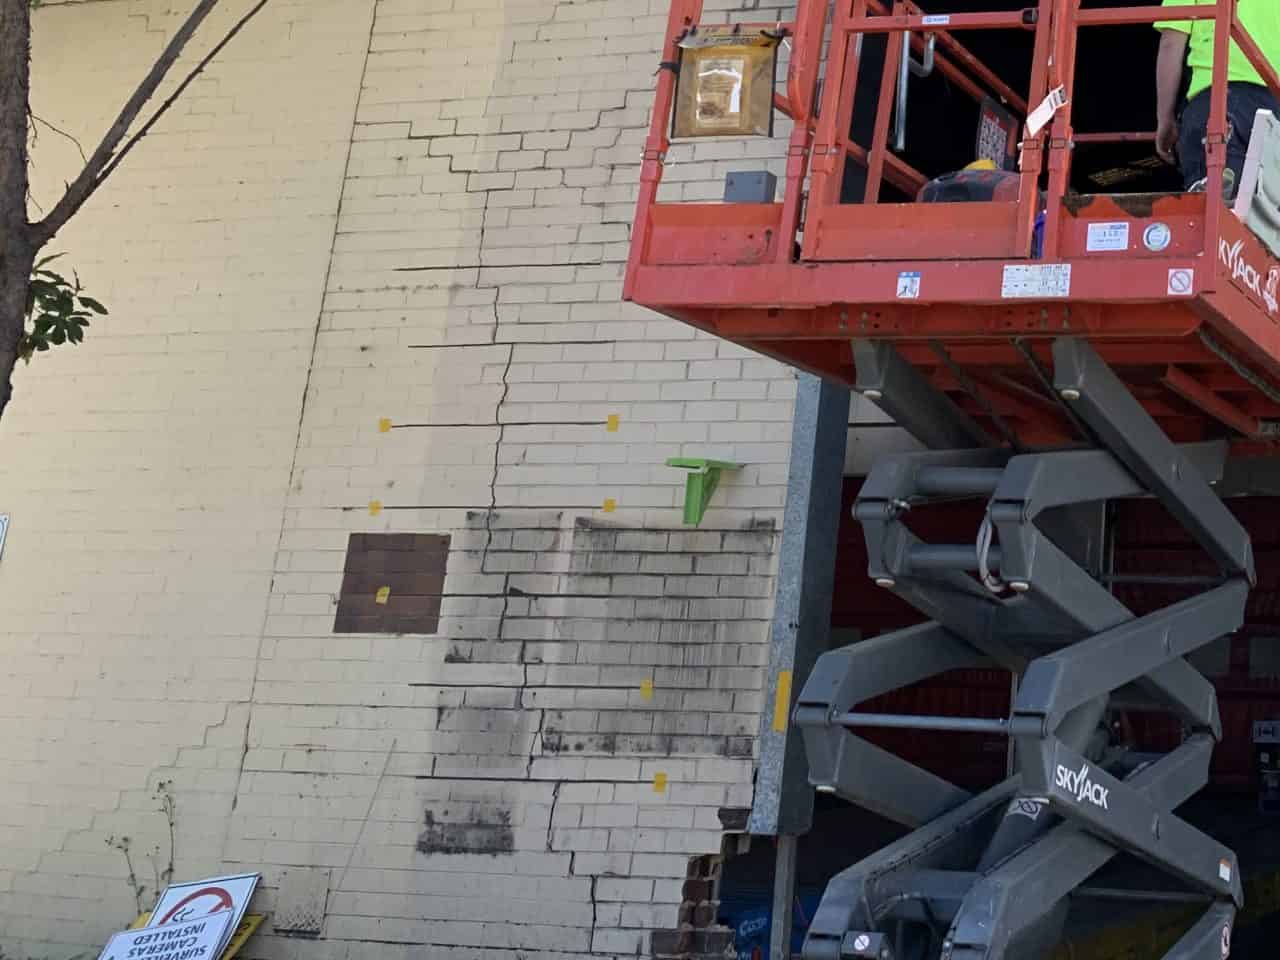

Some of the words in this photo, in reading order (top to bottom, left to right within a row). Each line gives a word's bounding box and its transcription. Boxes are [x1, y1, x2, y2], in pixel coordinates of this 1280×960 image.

[1218, 235, 1261, 297] KYJACK
[1055, 763, 1109, 810] SKYJACK
[127, 937, 198, 958] CAMERAS
[133, 922, 207, 946] INSTALLED
